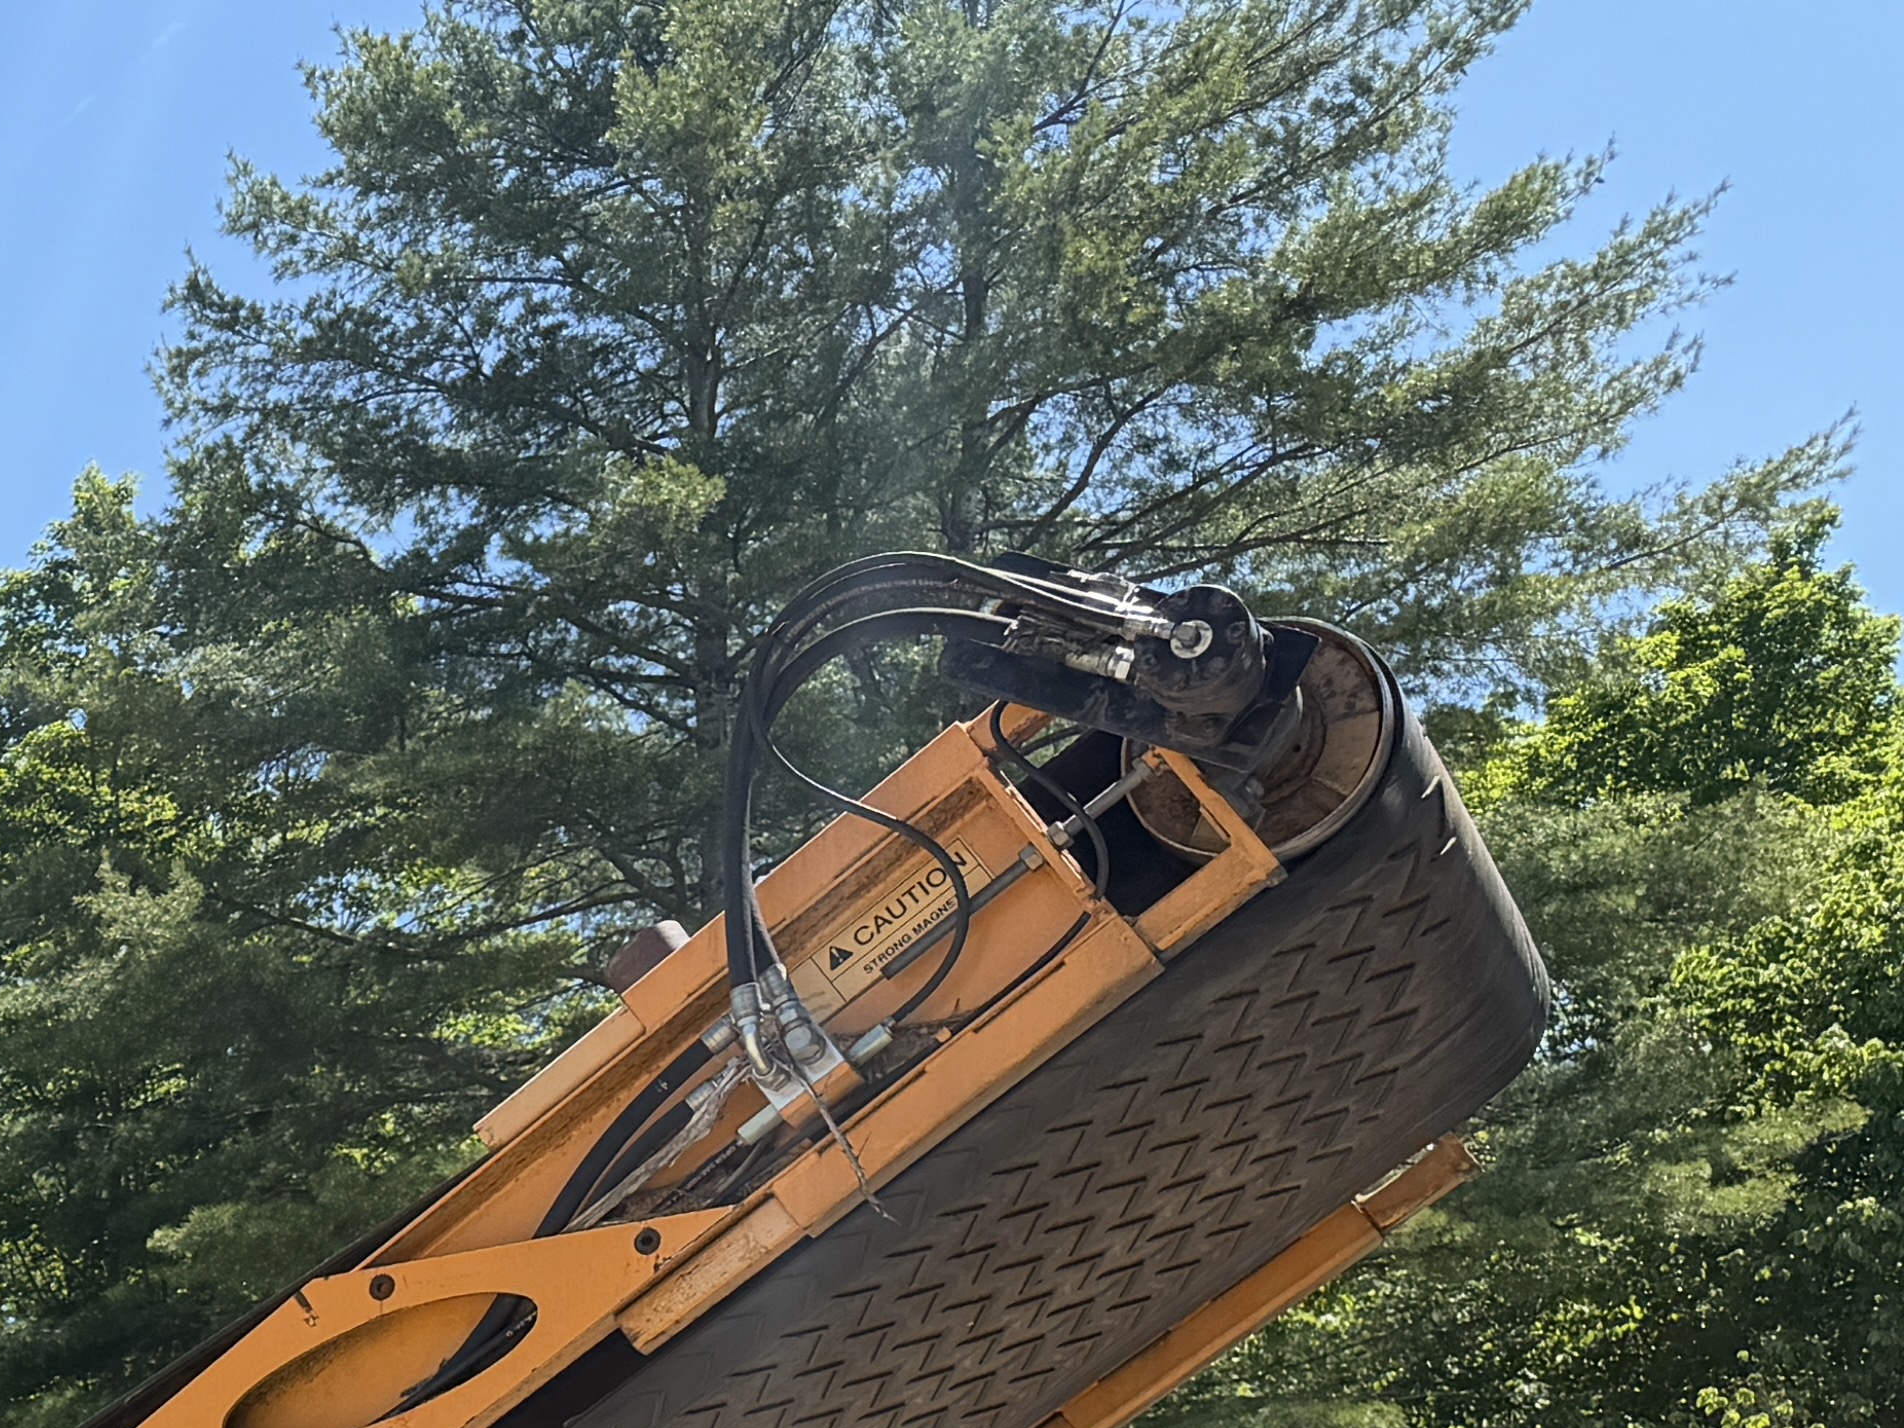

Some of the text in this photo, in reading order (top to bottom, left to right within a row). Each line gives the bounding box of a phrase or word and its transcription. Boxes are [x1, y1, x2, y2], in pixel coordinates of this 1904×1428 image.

[854, 851, 967, 946] CAUTION
[863, 896, 958, 974] STRONG MAGNE
